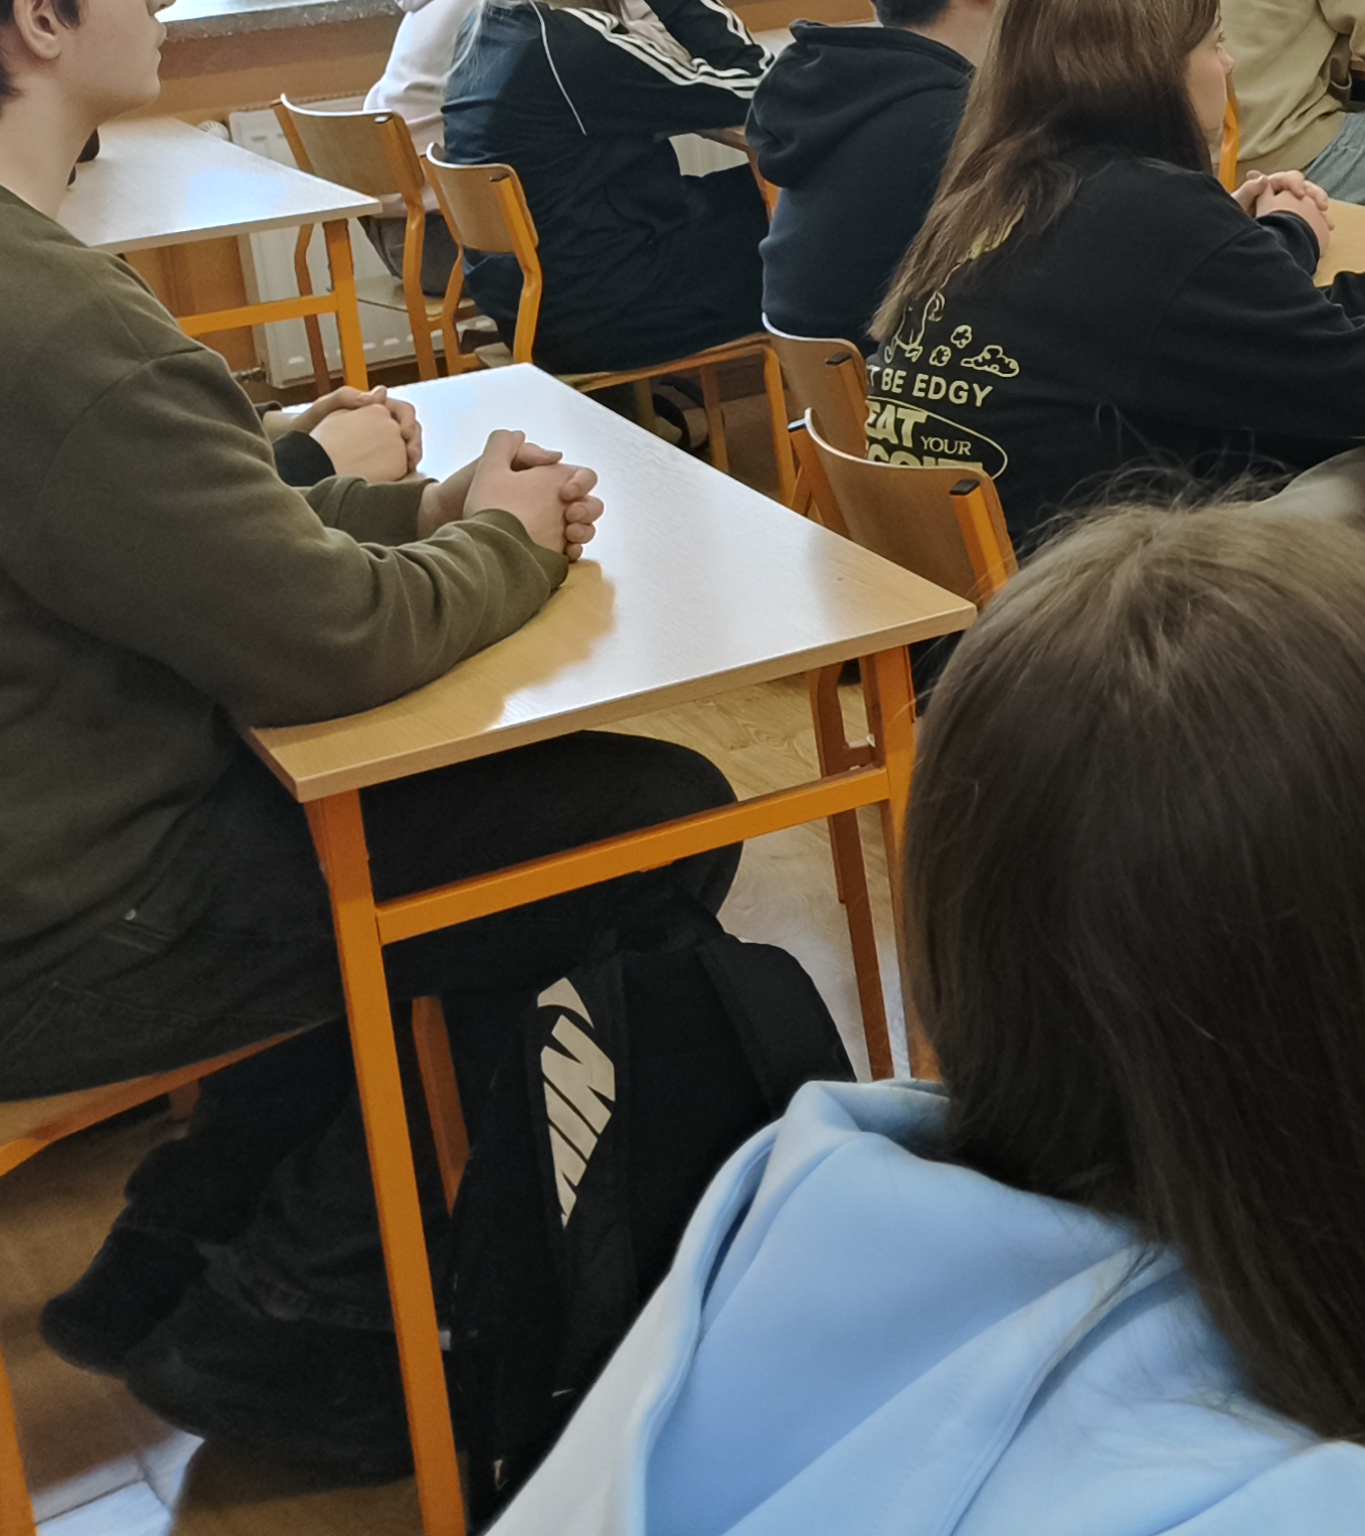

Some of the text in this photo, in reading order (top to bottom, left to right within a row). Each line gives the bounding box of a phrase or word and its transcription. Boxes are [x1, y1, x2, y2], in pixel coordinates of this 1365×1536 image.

[881, 368, 907, 394] BE
[912, 374, 993, 407] EDGY
[920, 436, 971, 456] YOUR
